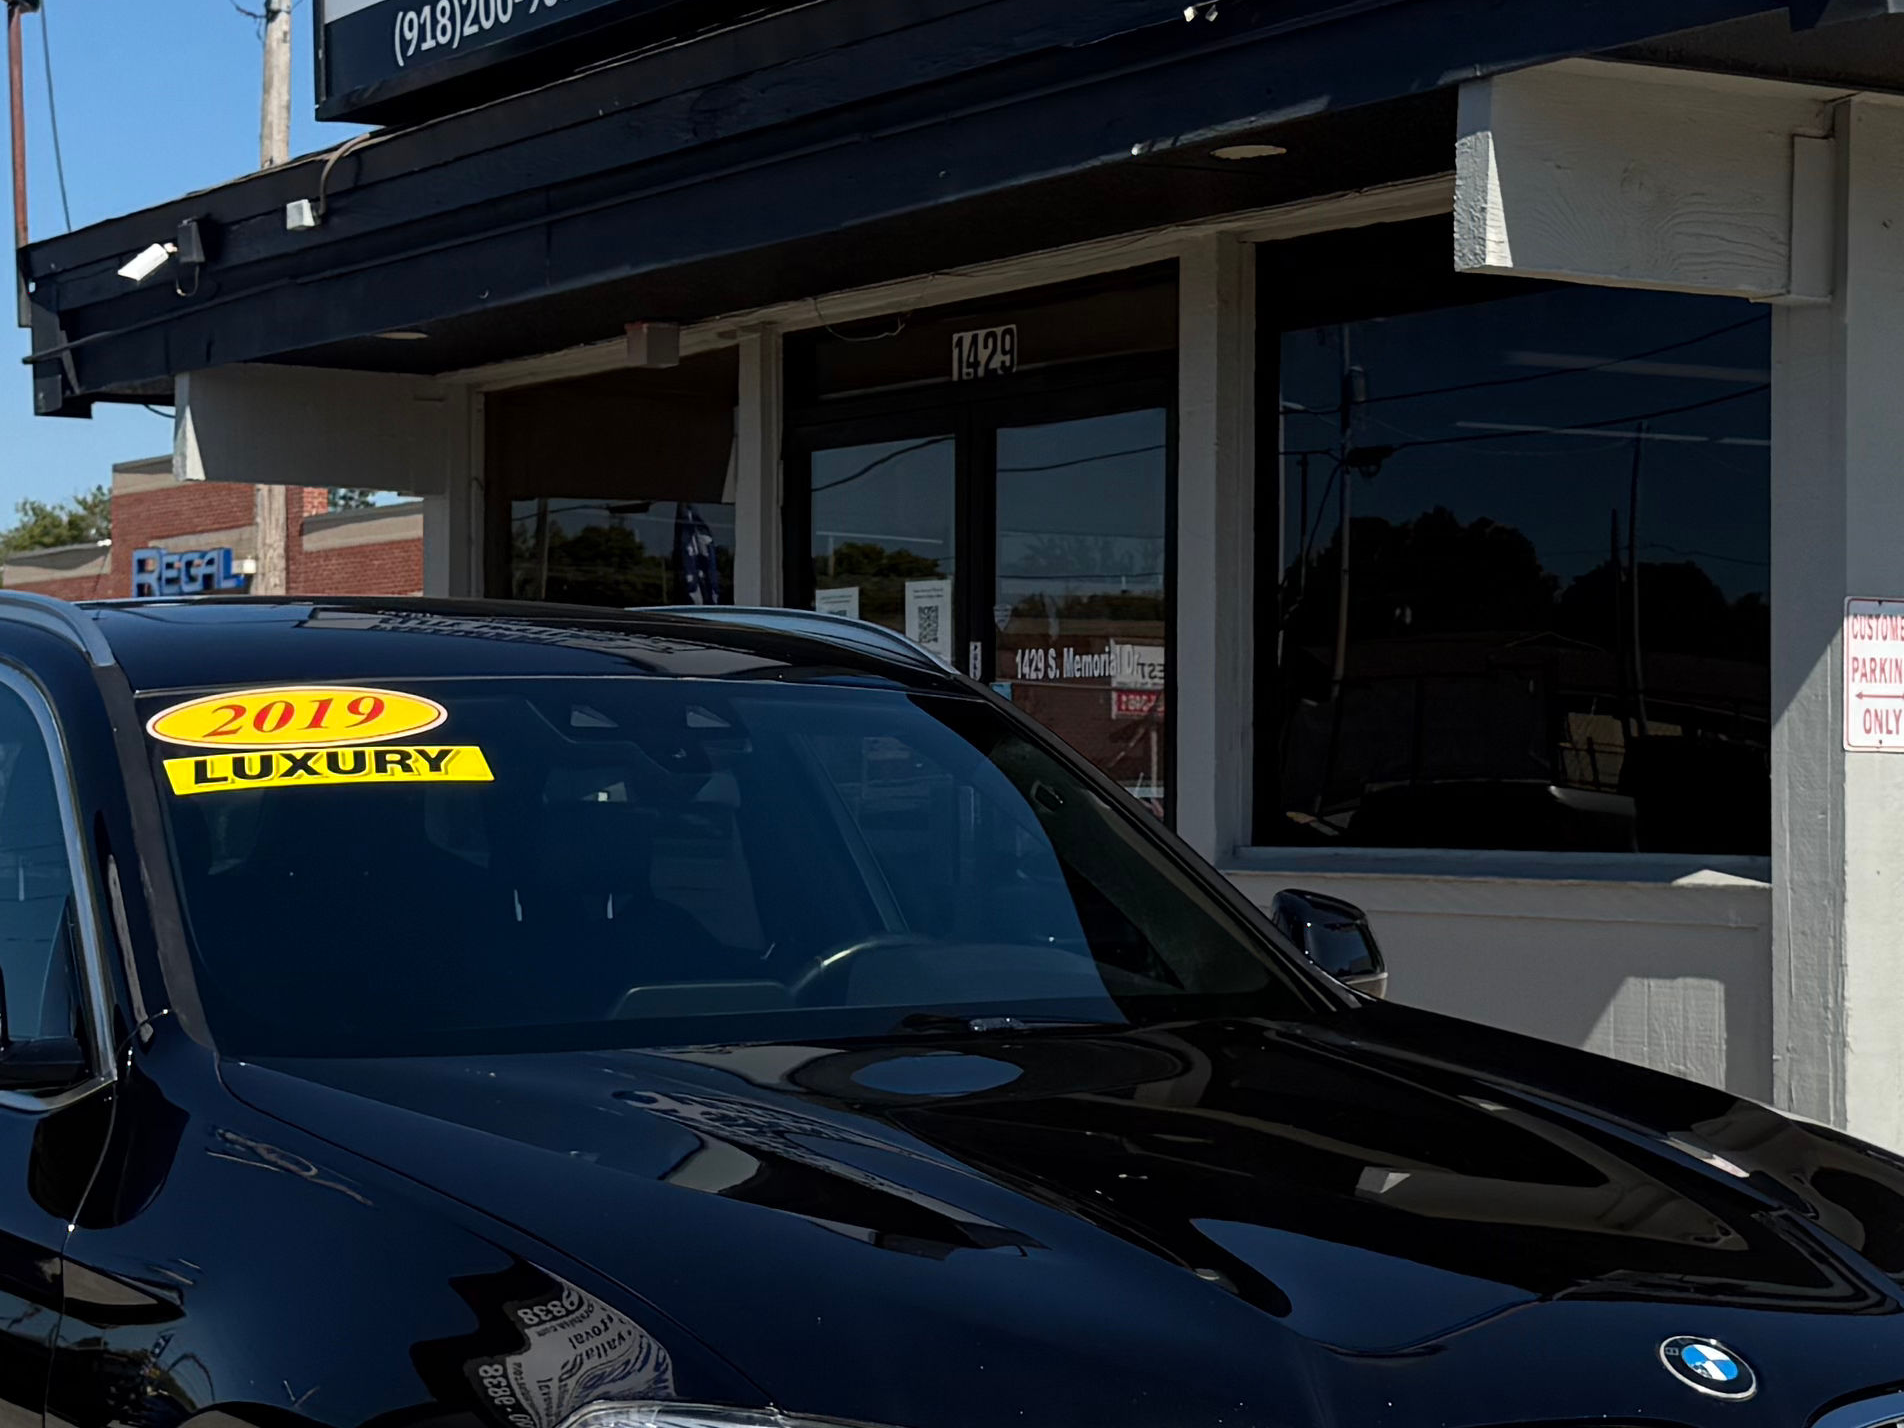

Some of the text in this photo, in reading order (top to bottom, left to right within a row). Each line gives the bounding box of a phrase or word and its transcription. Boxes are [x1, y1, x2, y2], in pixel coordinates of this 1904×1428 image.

[954, 327, 1015, 381] 1429
[132, 546, 245, 598] REGAL
[1016, 648, 1045, 680] 1429
[1047, 647, 1060, 679] S.
[1063, 644, 1121, 678] Memorial
[202, 696, 385, 738] 2019
[1863, 708, 1903, 735] ONLY
[194, 749, 456, 785] LUXURY
